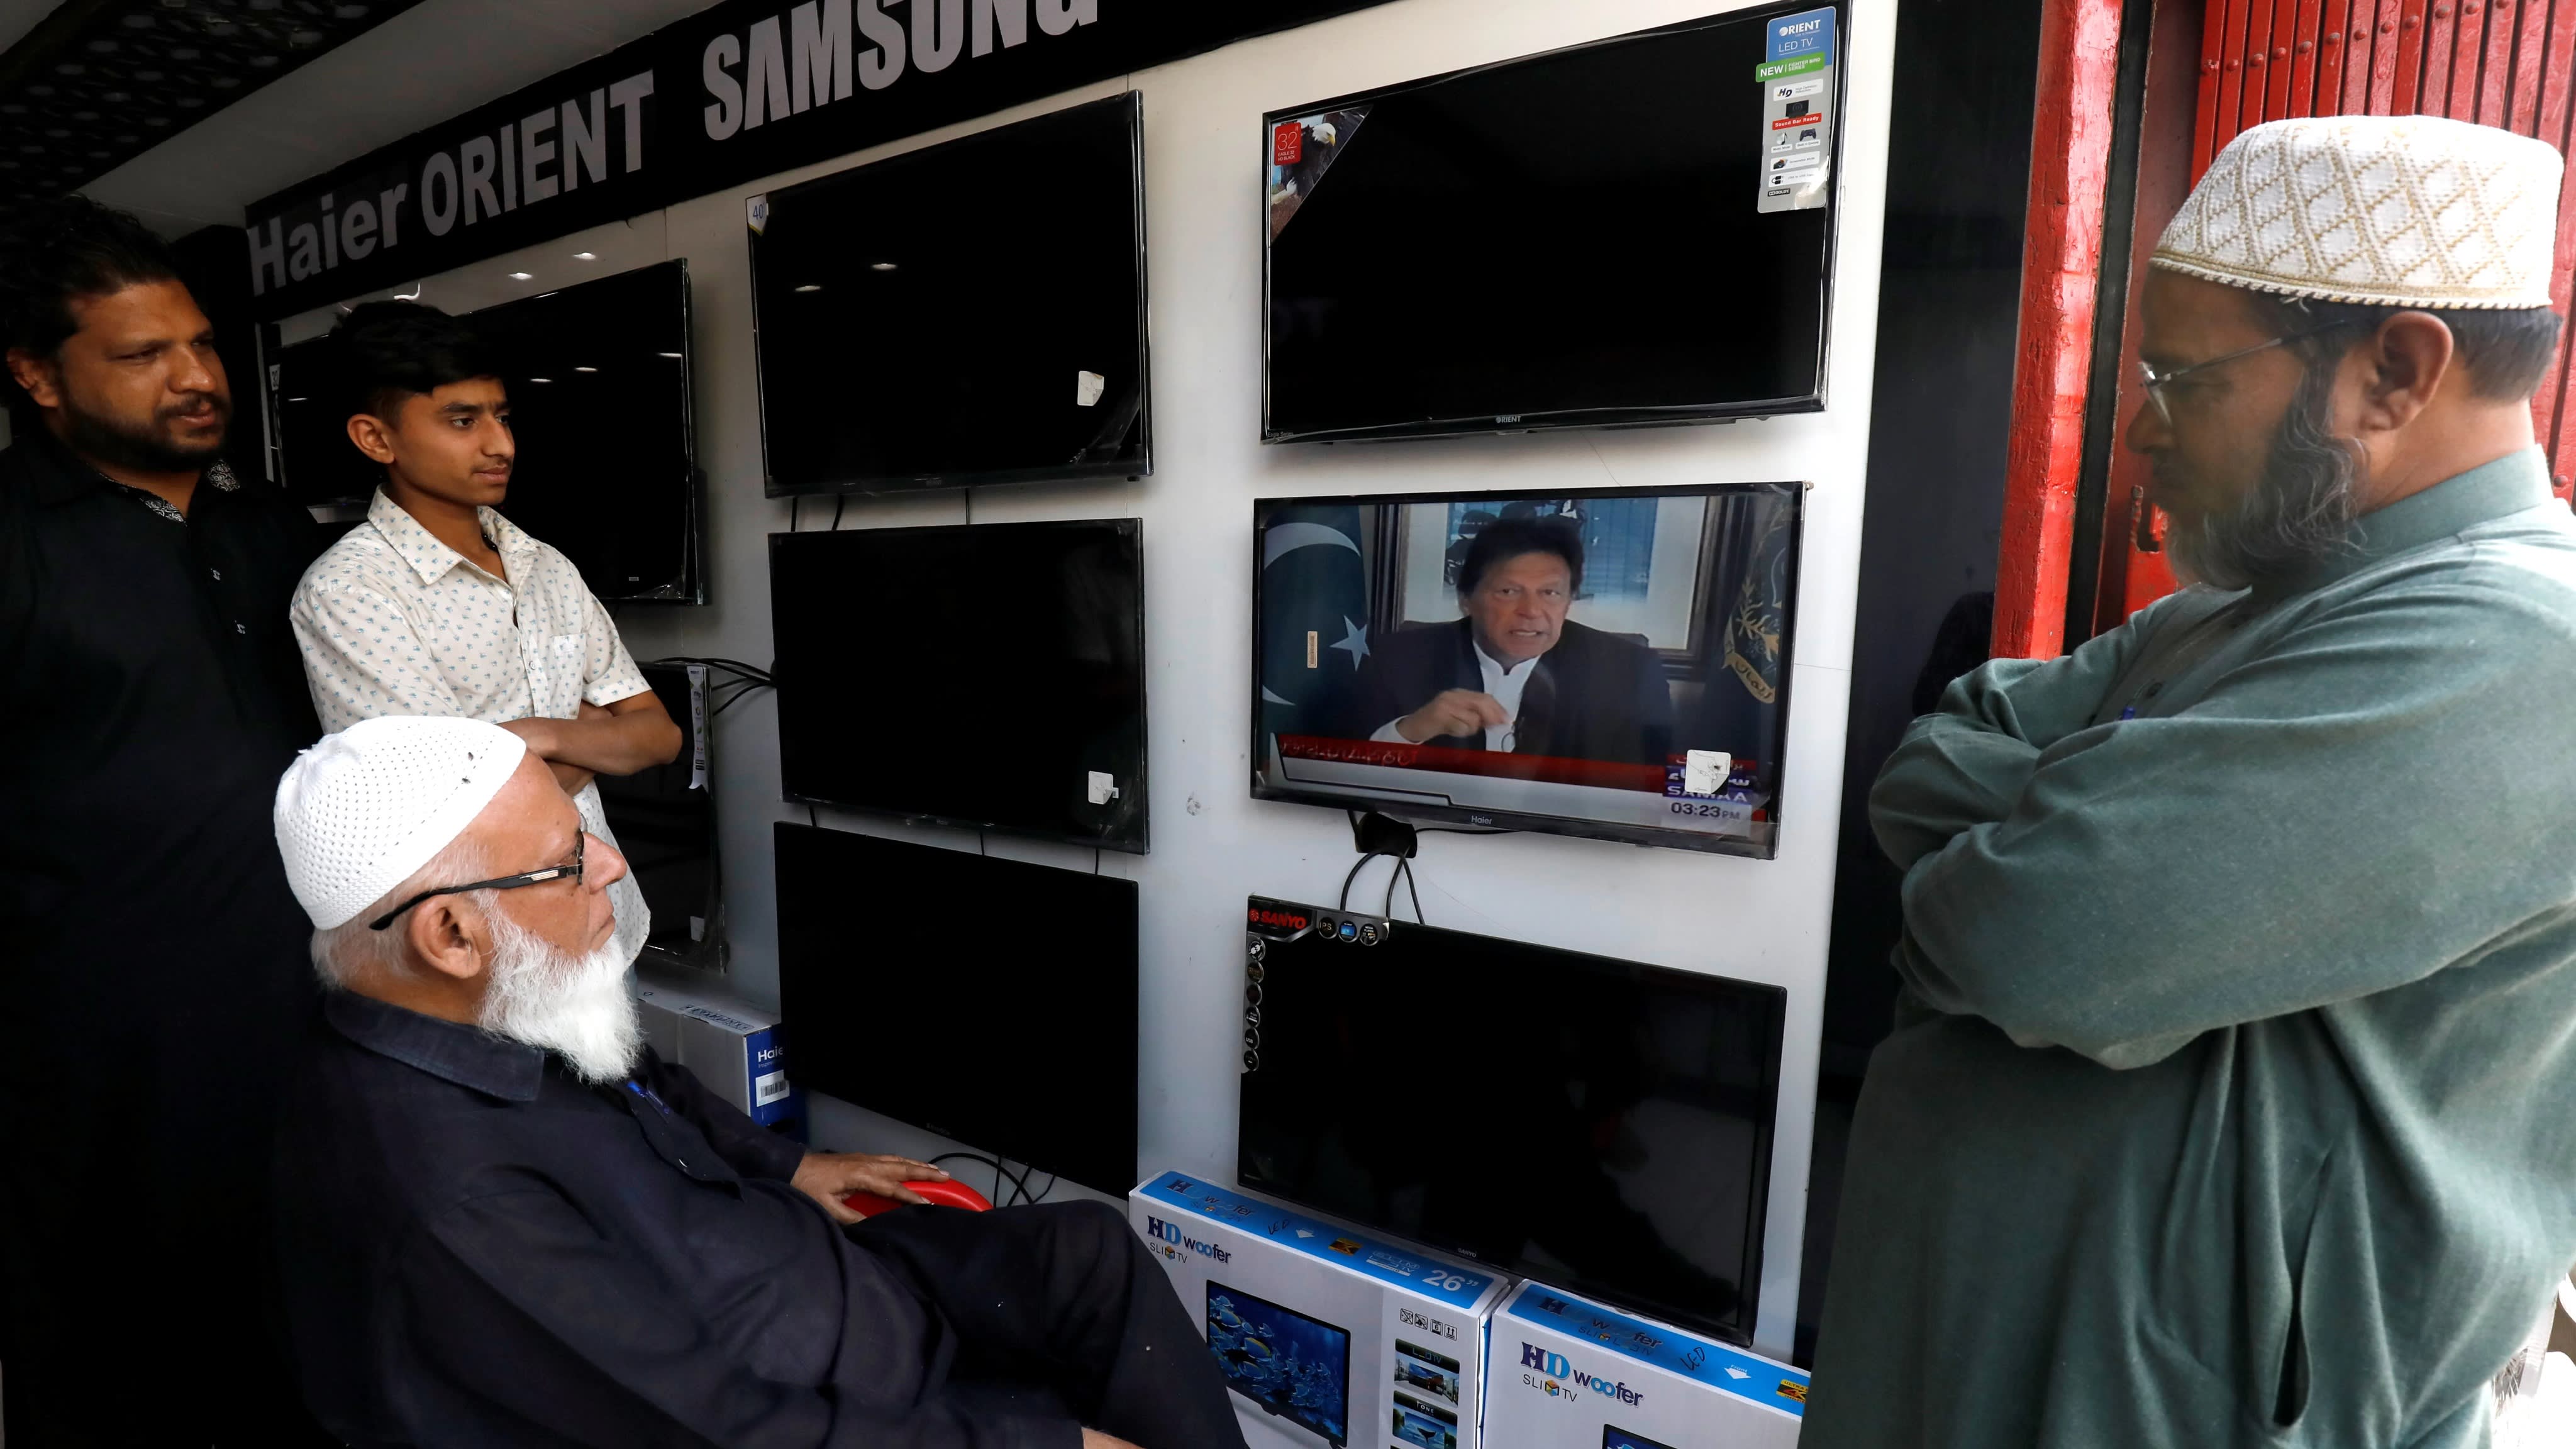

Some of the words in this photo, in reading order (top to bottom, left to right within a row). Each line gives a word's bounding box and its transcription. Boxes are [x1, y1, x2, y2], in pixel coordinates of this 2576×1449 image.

[1779, 41, 1798, 52] LED
[1801, 38, 1813, 47] TV
[1760, 65, 1784, 77] NEW
[247, 182, 408, 297] Haier
[421, 69, 654, 236] ORIENT
[702, 0, 1097, 142] SAMSUN
[1672, 802, 1721, 818] 03:23
[1722, 810, 1740, 819] PM
[1471, 816, 1492, 824] Haier
[1261, 911, 1306, 930] SANYO
[758, 1045, 784, 1062] Haie
[1147, 1215, 1182, 1245] HD
[1183, 1235, 1231, 1263] woofer
[1177, 1252, 1187, 1263] TV
[1520, 1341, 1570, 1380] HD
[1573, 1368, 1644, 1407] woofer
[1731, 1364, 1748, 1372] Front
[1562, 1387, 1577, 1402] TV
